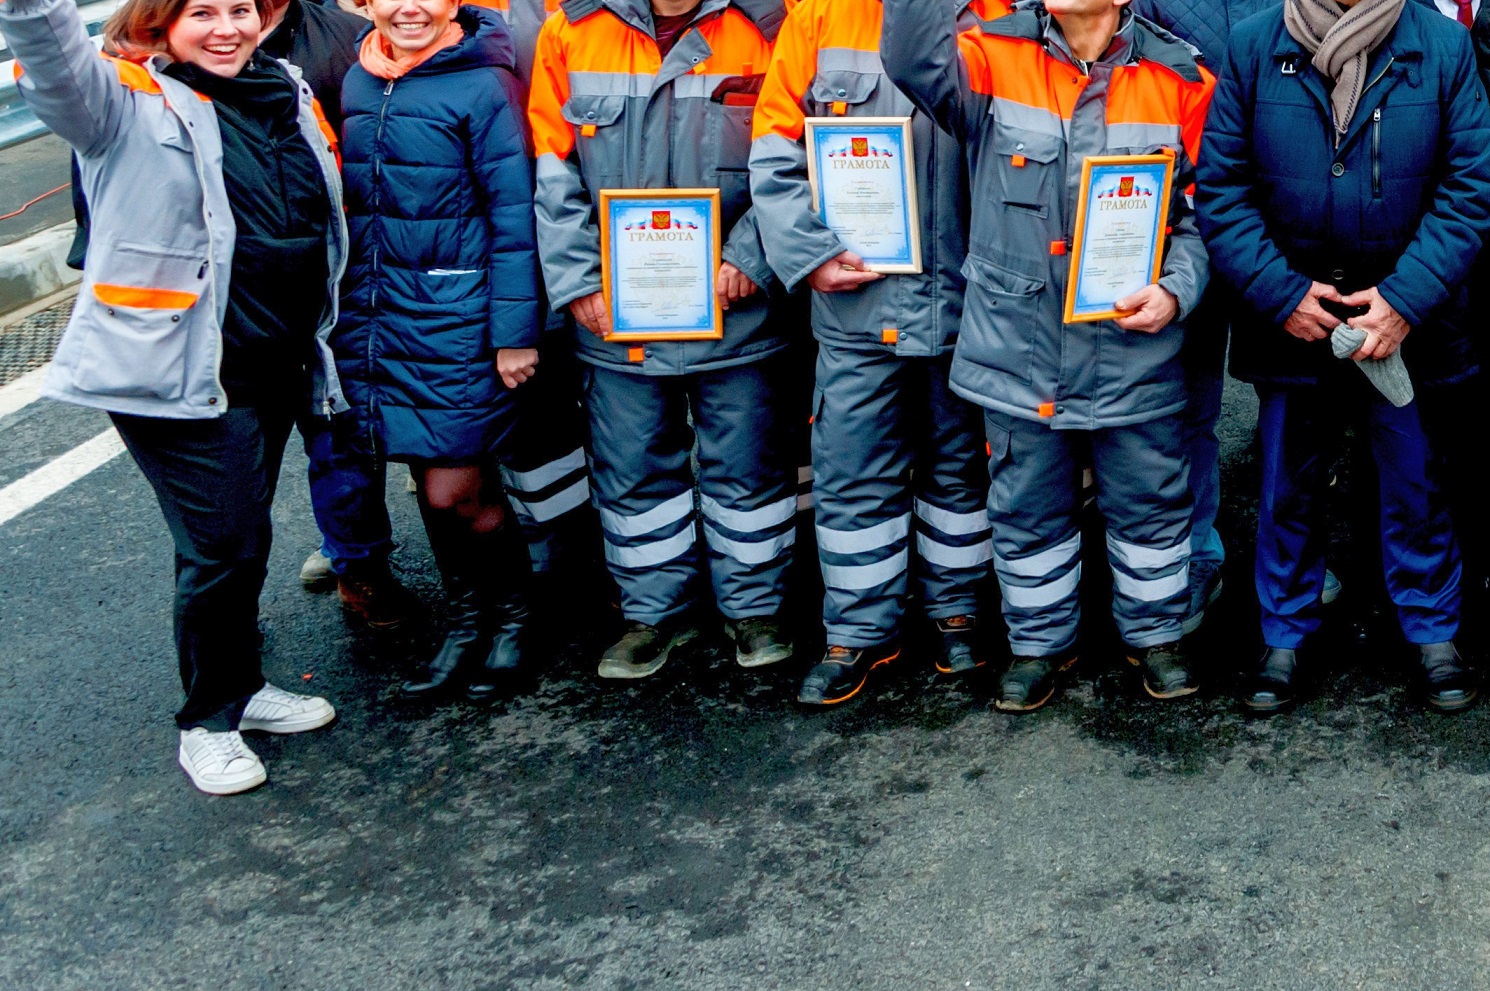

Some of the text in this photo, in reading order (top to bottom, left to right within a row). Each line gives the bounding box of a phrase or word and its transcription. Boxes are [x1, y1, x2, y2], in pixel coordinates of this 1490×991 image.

[833, 159, 890, 170] ГРАМОТА
[1099, 199, 1148, 211] ГРАМОТА
[629, 231, 694, 242] ГРАМОТА
